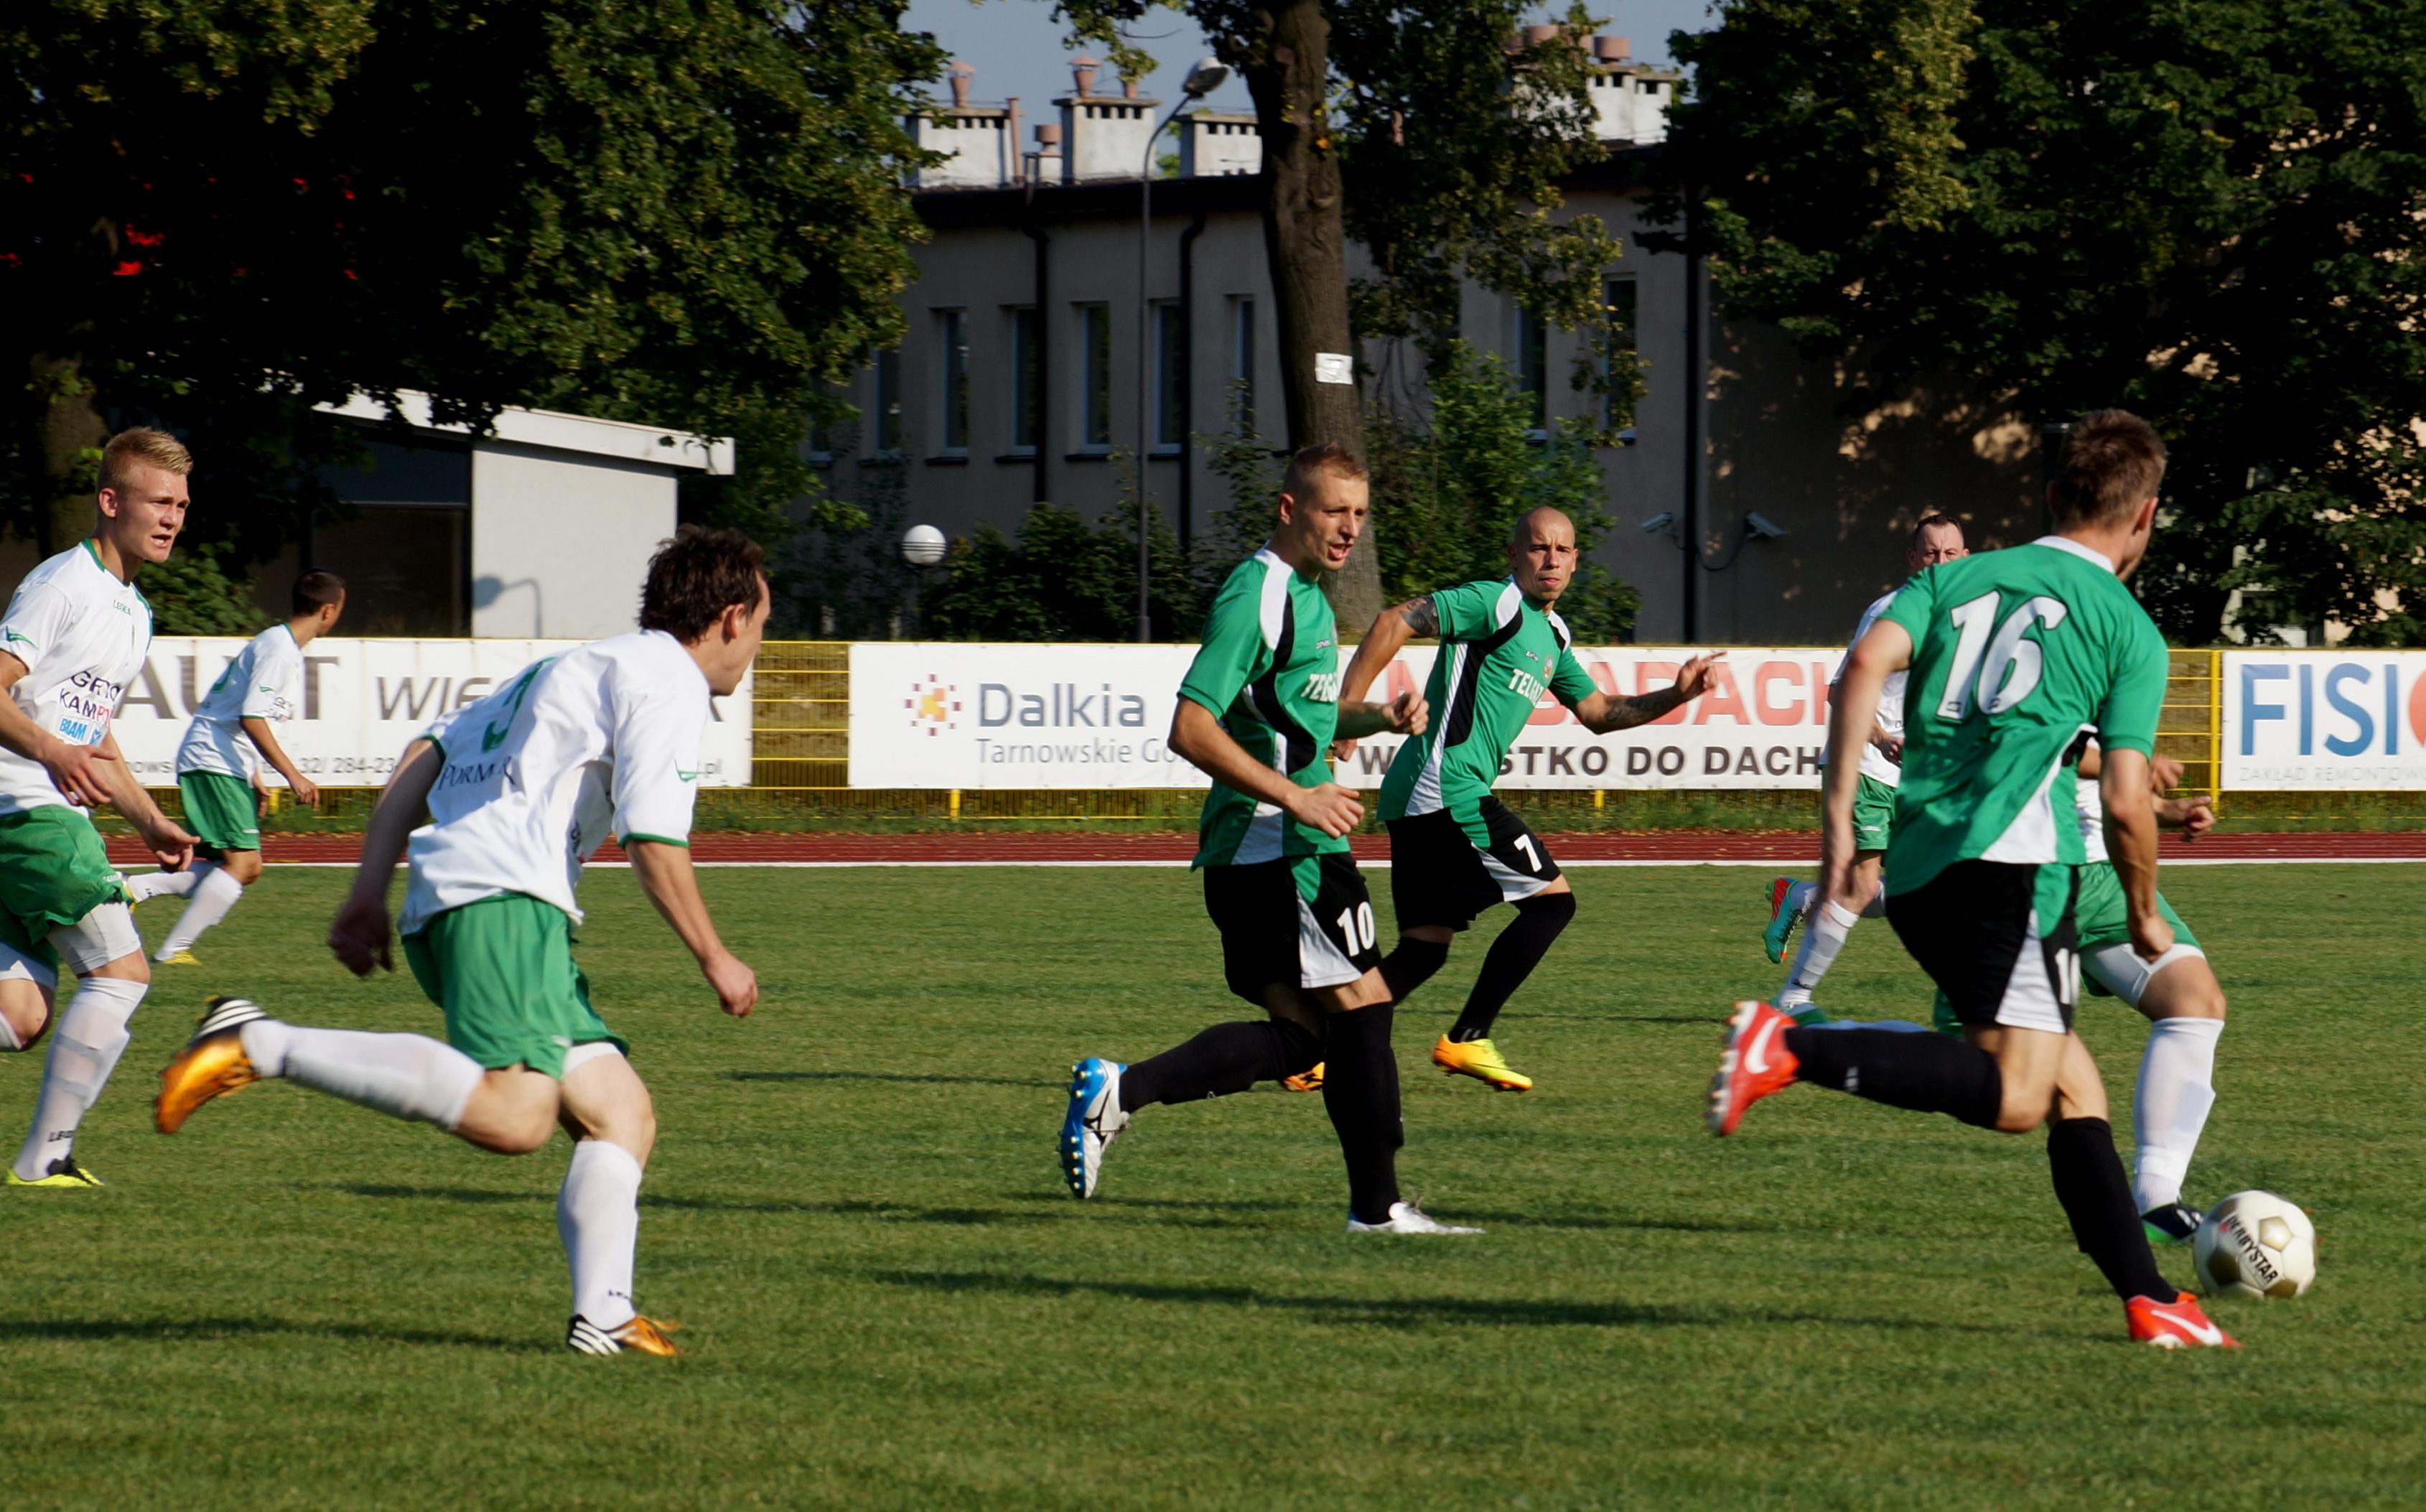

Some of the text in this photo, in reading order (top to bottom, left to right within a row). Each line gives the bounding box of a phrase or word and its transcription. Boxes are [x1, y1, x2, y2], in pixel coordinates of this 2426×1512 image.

[1936, 589, 2068, 720] 16
[979, 683, 1144, 727] Dalkia
[976, 738, 1132, 763] Tarnowskie
[1627, 745, 1685, 776] DO
[2315, 767, 2426, 781] REMONTOW
[1513, 834, 1542, 873] 7
[1337, 901, 1376, 957] 10
